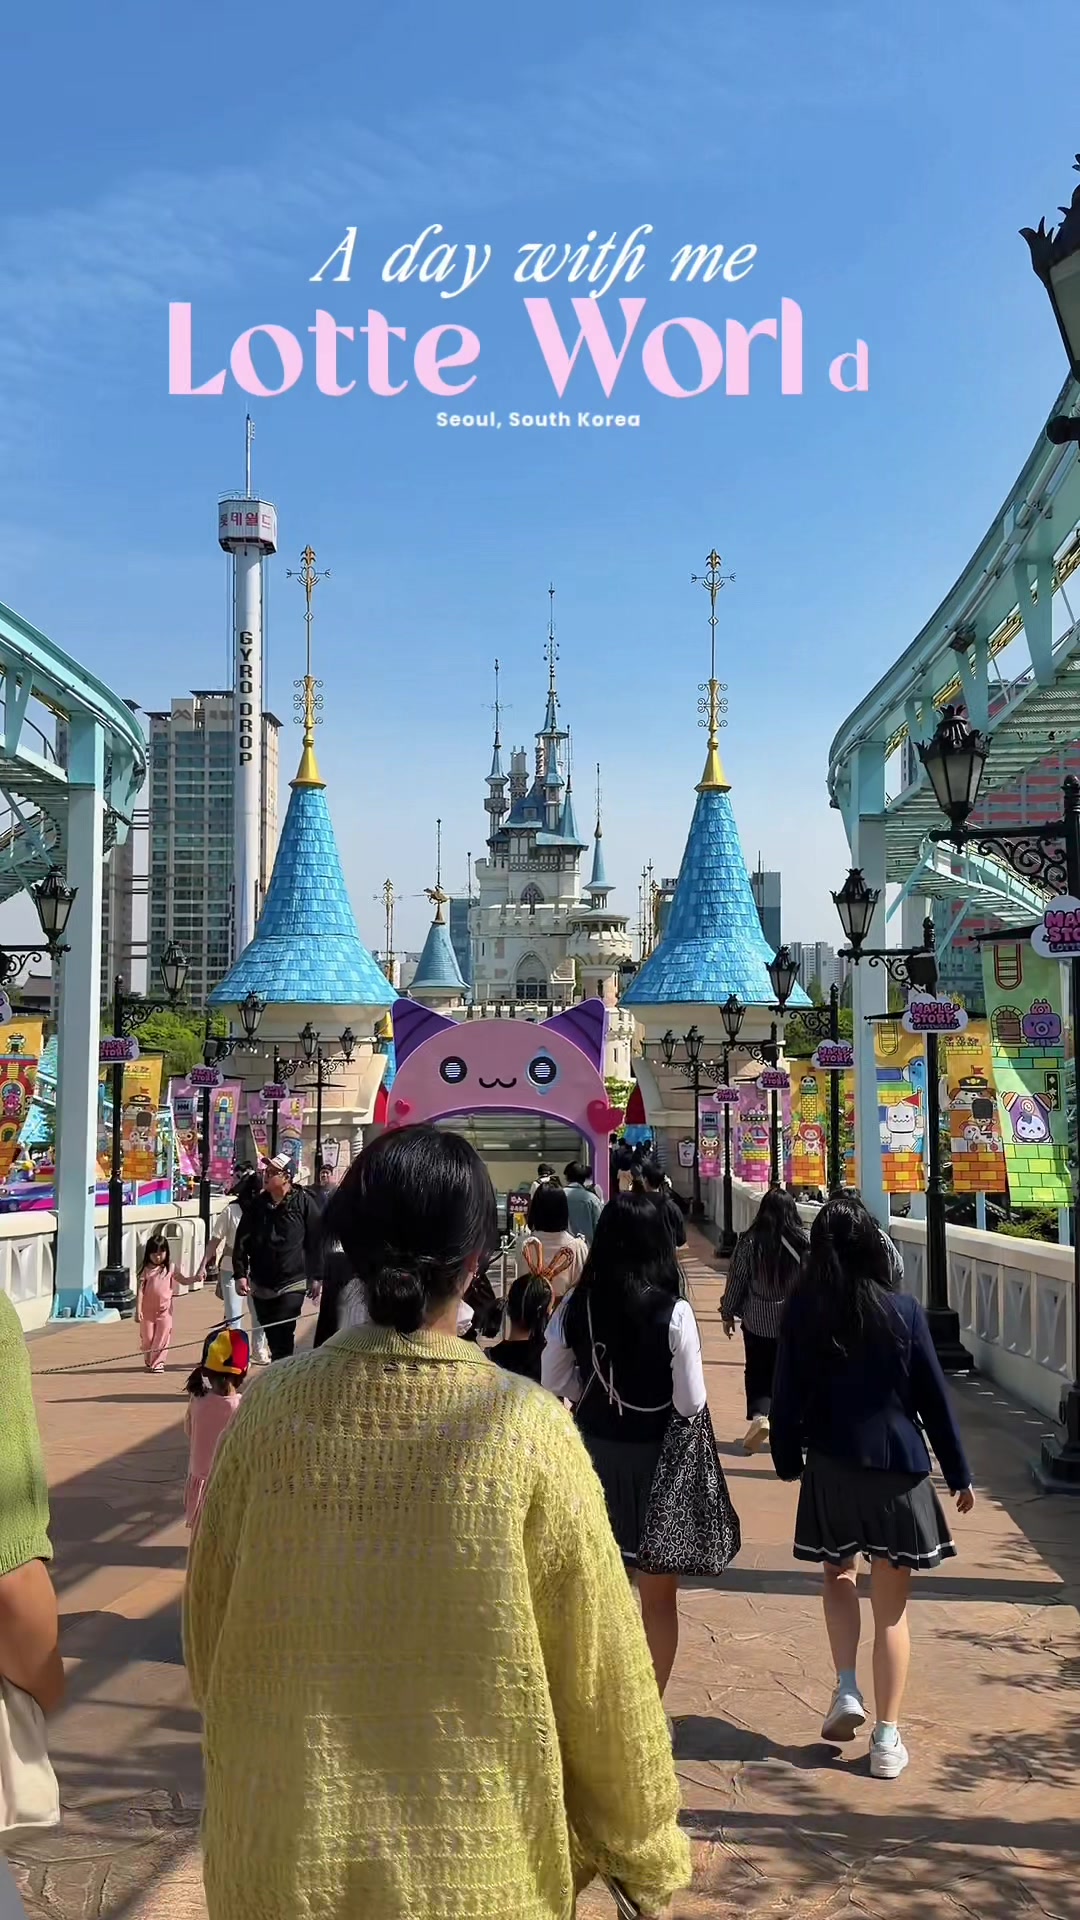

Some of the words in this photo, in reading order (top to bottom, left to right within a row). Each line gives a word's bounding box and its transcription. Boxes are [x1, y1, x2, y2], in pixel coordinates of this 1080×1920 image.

[220, 512, 271, 530] 롯데월드
[239, 631, 253, 693] GYRO
[239, 702, 253, 766] DROP
[910, 1002, 953, 1014] MAPLE
[912, 1013, 955, 1024] STORY
